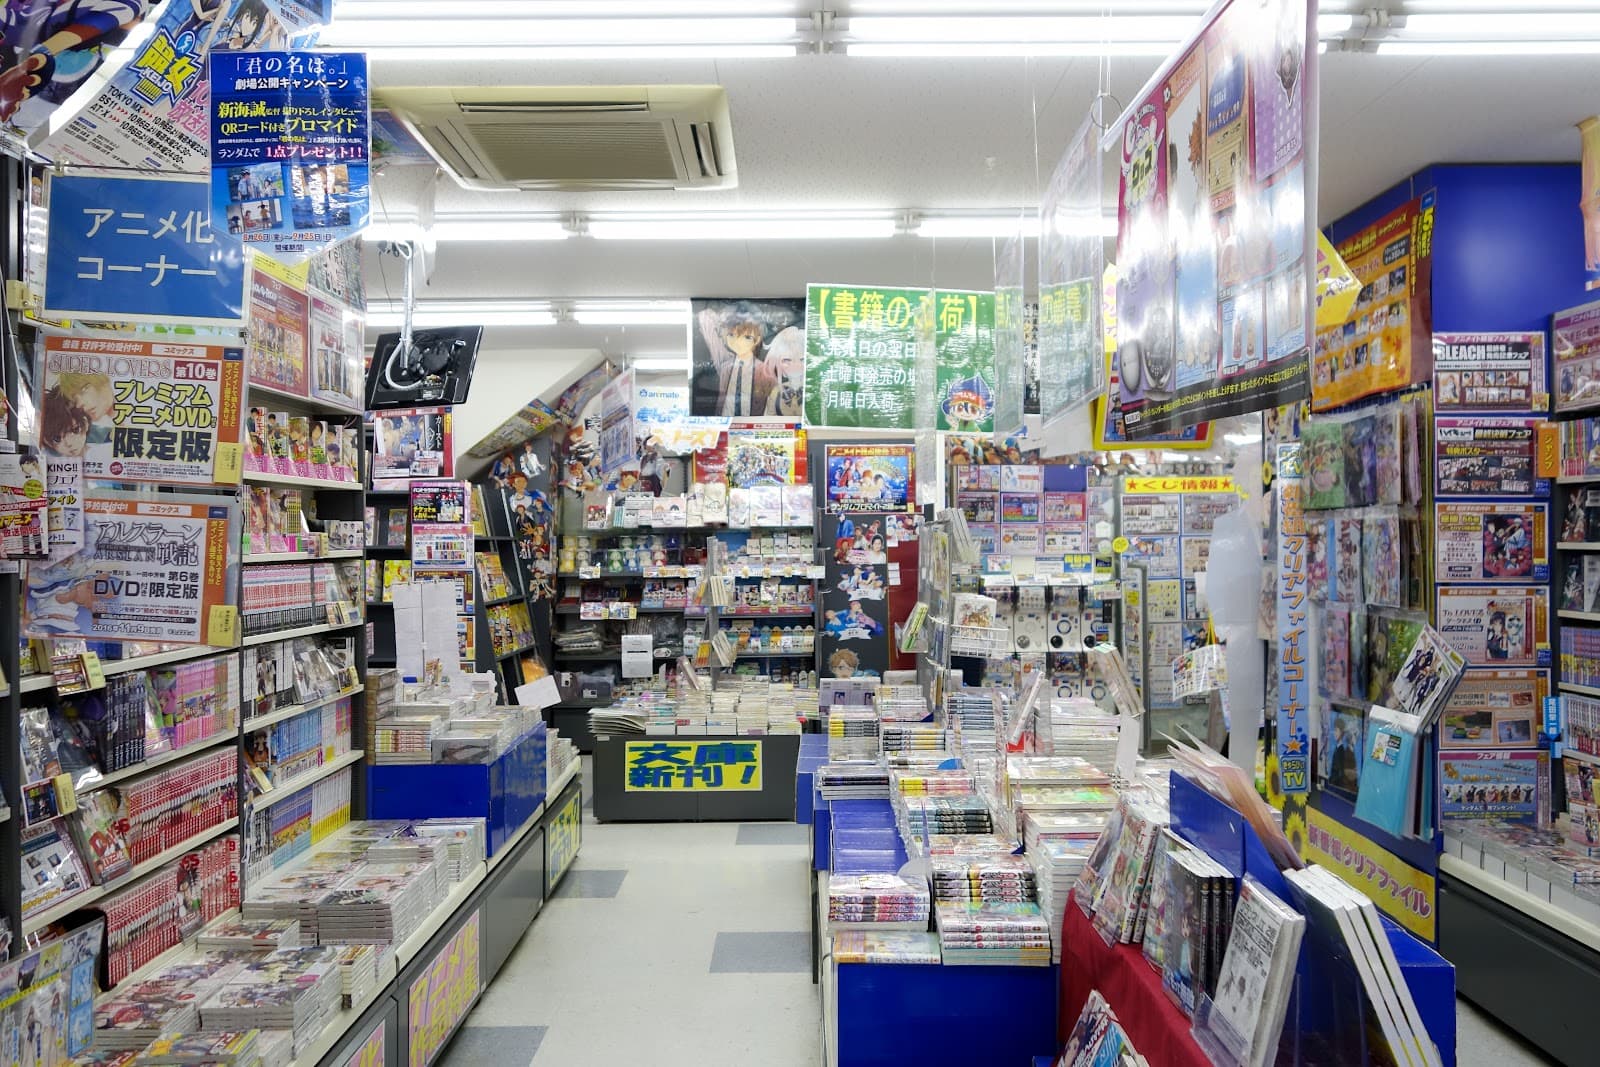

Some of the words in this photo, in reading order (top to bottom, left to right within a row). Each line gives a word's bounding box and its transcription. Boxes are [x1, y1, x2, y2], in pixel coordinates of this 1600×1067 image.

[235, 56, 348, 75] 「君の名は。」
[234, 77, 349, 90] 劇場公開キャンペーン
[98, 94, 118, 109] BS11
[106, 85, 133, 106] TOKYO
[130, 101, 143, 113] MX
[89, 103, 109, 118] AT-X
[221, 117, 358, 134] QRコード付きブロマイド
[218, 148, 261, 158] ランダムで
[82, 208, 215, 244] アニメ化
[77, 254, 217, 287] コーナー
[817, 288, 977, 334] 【書籍の荷】
[163, 347, 194, 355] コミックス
[1436, 344, 1486, 360] BLEACH
[48, 353, 101, 374] SUPER
[107, 356, 172, 379] LOVERS
[175, 361, 218, 380] 第10巻
[114, 381, 213, 407] プレミアム
[112, 427, 211, 463] 限定版
[1544, 434, 1553, 470] ジャンプ
[1143, 480, 1218, 490] くじ情報
[95, 520, 202, 545] アルスラーン
[158, 541, 199, 566] 戦記
[168, 571, 199, 582] 第6巻
[94, 579, 199, 599] DVD付き限定版
[629, 743, 757, 765] 文庫
[629, 765, 757, 788] 新刊!
[1283, 771, 1305, 788] TV
